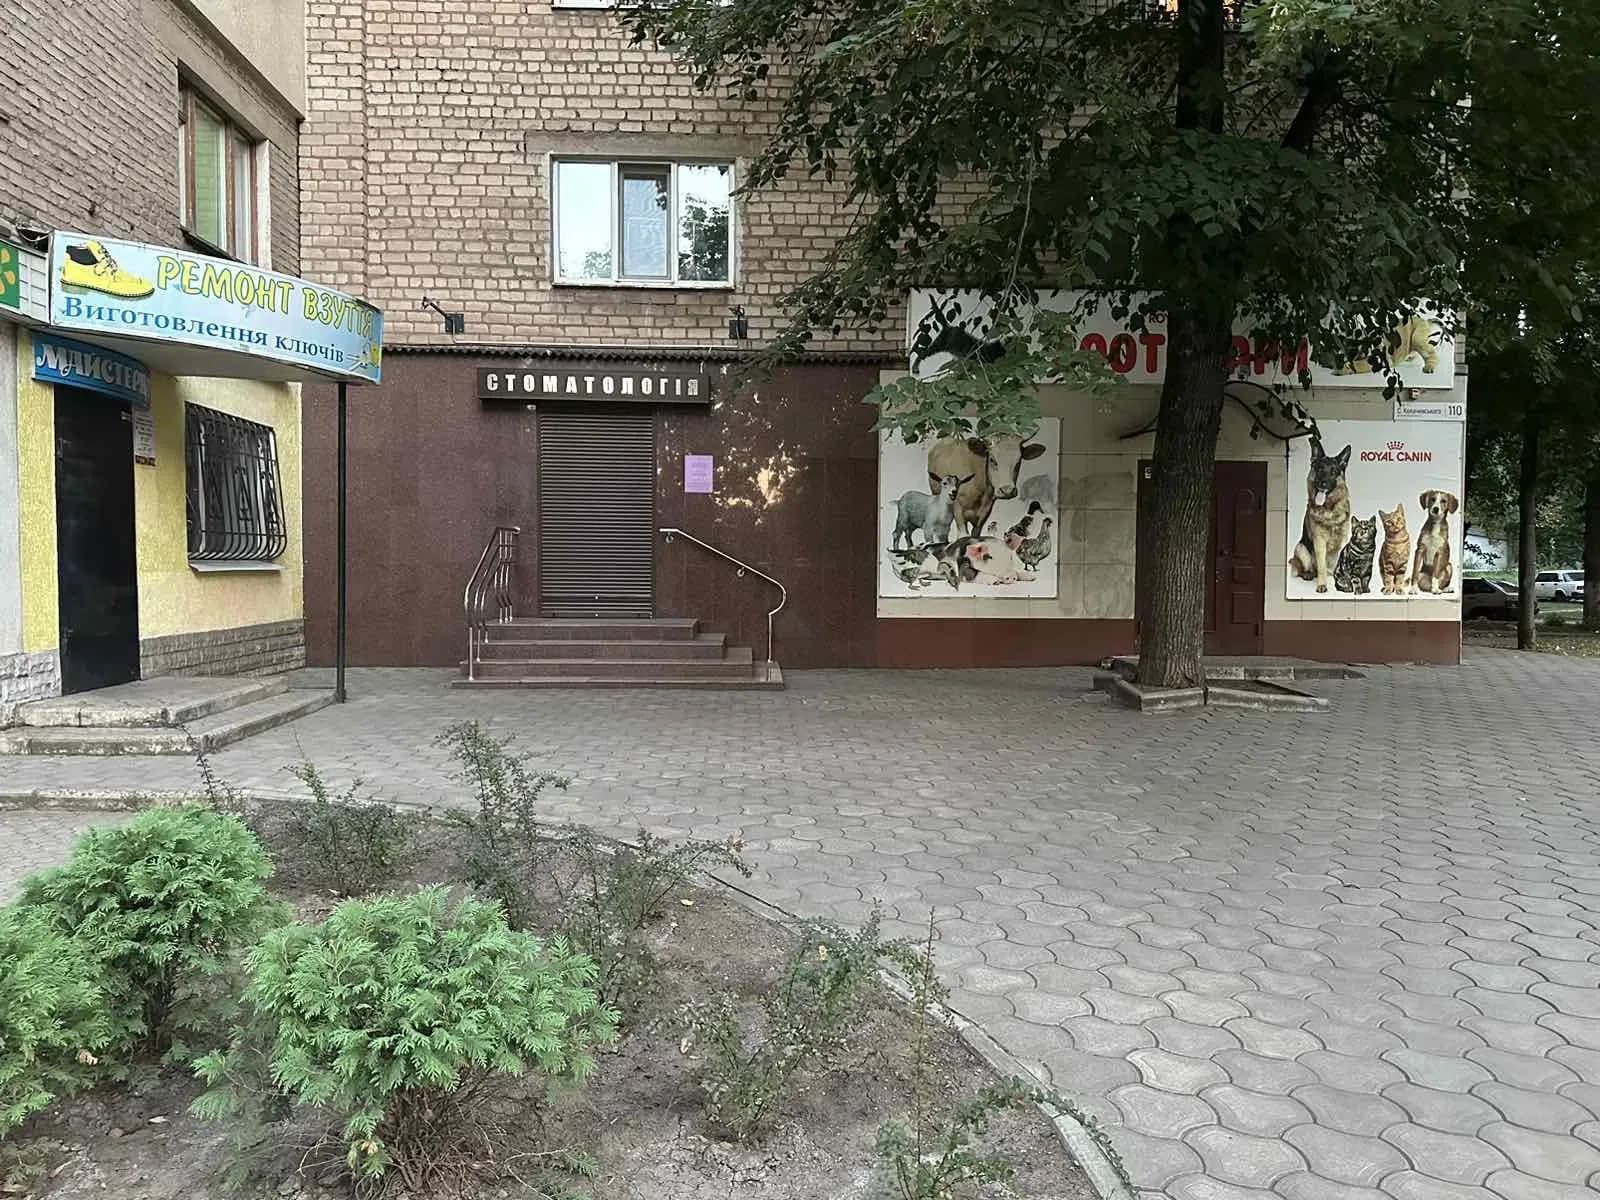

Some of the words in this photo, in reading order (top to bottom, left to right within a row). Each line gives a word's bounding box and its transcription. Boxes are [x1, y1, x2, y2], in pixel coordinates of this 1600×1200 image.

[157, 255, 294, 315] РЕМОНТ
[303, 287, 374, 338] ВЗУТТЯ
[64, 296, 268, 346] Виготовлення
[275, 334, 344, 363] ключів
[486, 373, 699, 396] СТОМАТОЛОГІЯ
[1448, 405, 1462, 416] 110
[1360, 451, 1394, 462] ROYAL
[1396, 451, 1432, 462] CANIN
